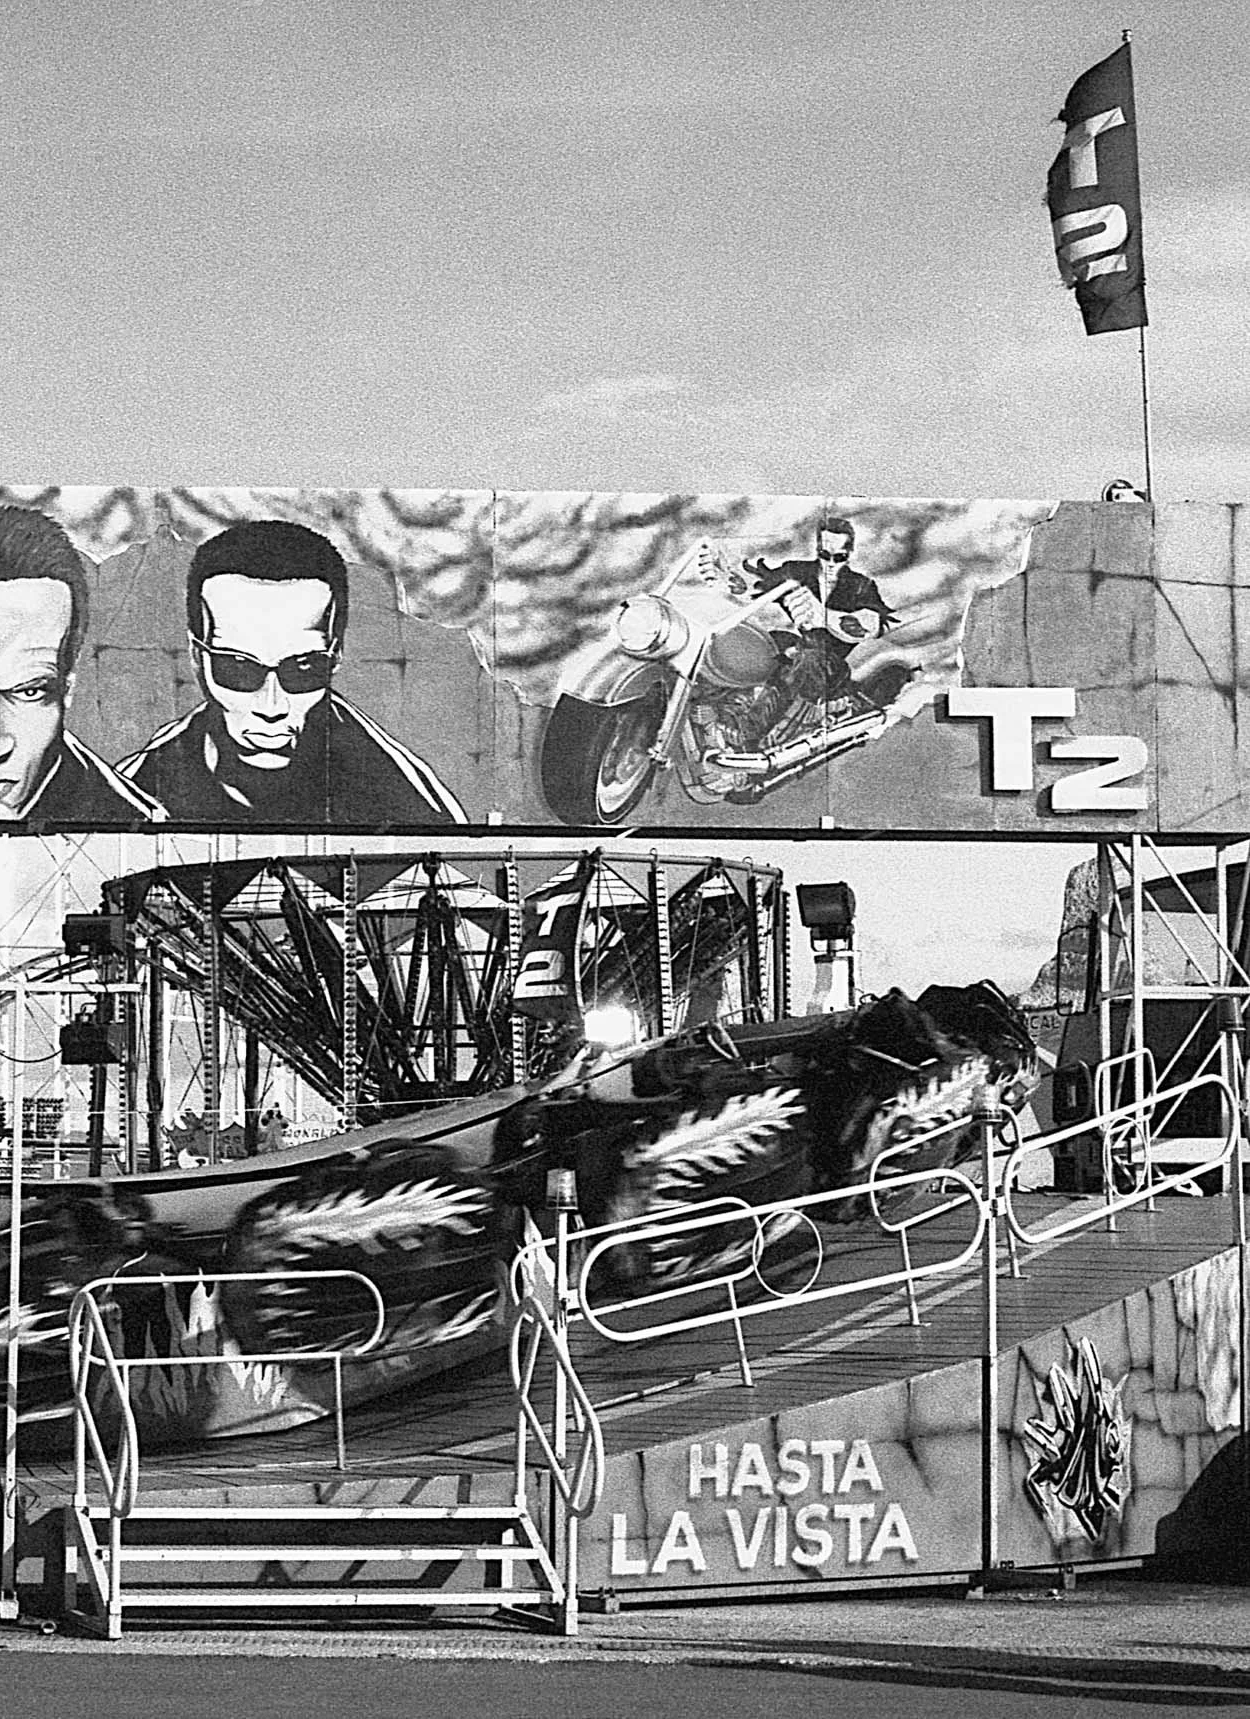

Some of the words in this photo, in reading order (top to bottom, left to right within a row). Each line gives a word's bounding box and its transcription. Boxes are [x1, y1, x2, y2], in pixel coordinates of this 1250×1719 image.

[948, 687, 1148, 813] T2
[513, 892, 581, 999] T2
[689, 1438, 885, 1497] HASTA
[611, 1510, 707, 1576] LA
[725, 1502, 919, 1569] VISTA
